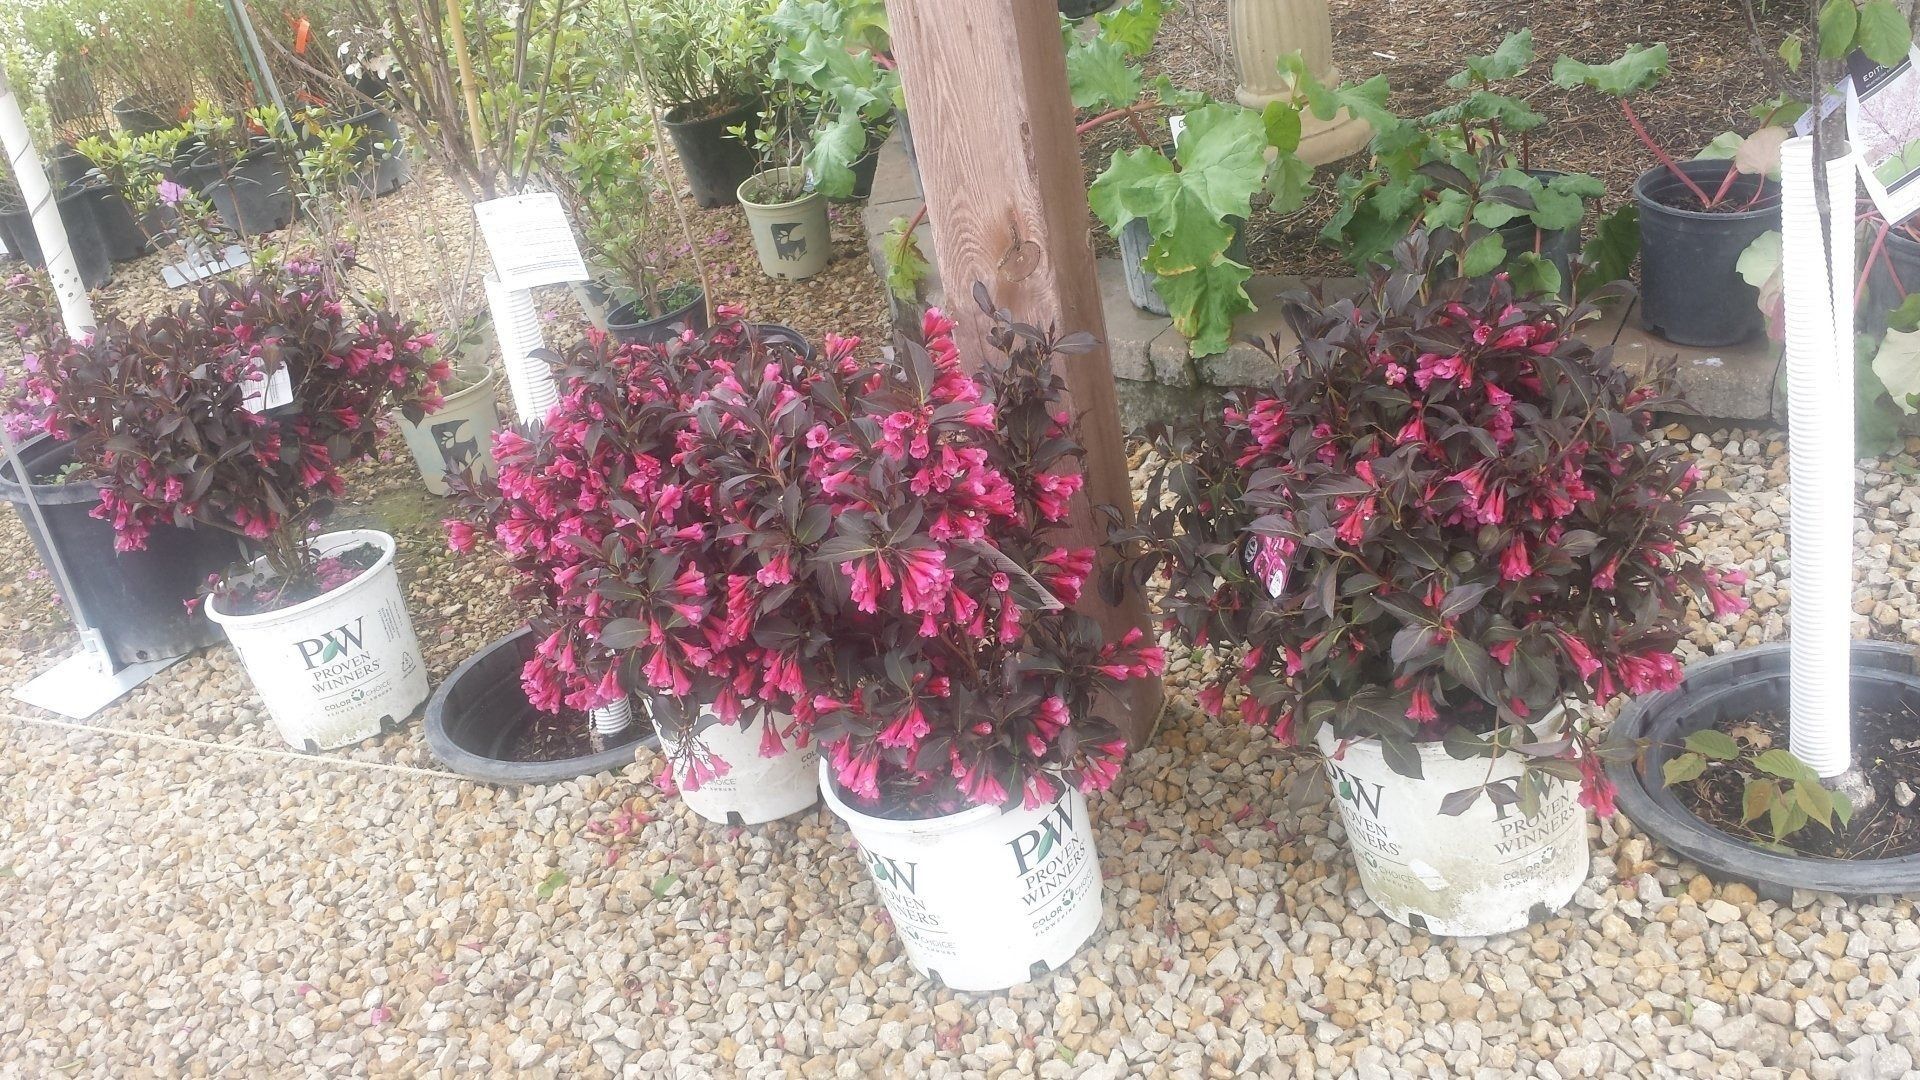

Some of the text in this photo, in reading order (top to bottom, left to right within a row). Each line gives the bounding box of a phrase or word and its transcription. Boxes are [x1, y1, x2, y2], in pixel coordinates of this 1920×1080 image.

[292, 615, 364, 671] PW
[313, 650, 371, 681] PROVEN
[324, 698, 351, 711] COLOR
[801, 750, 817, 763] COL
[1341, 803, 1388, 838] OVEN
[1501, 789, 1570, 838] PROVEN
[1005, 785, 1073, 878] PW
[1025, 831, 1079, 890] PROVEN
[881, 886, 926, 911] OVEN
[1032, 905, 1063, 930] COLOR
